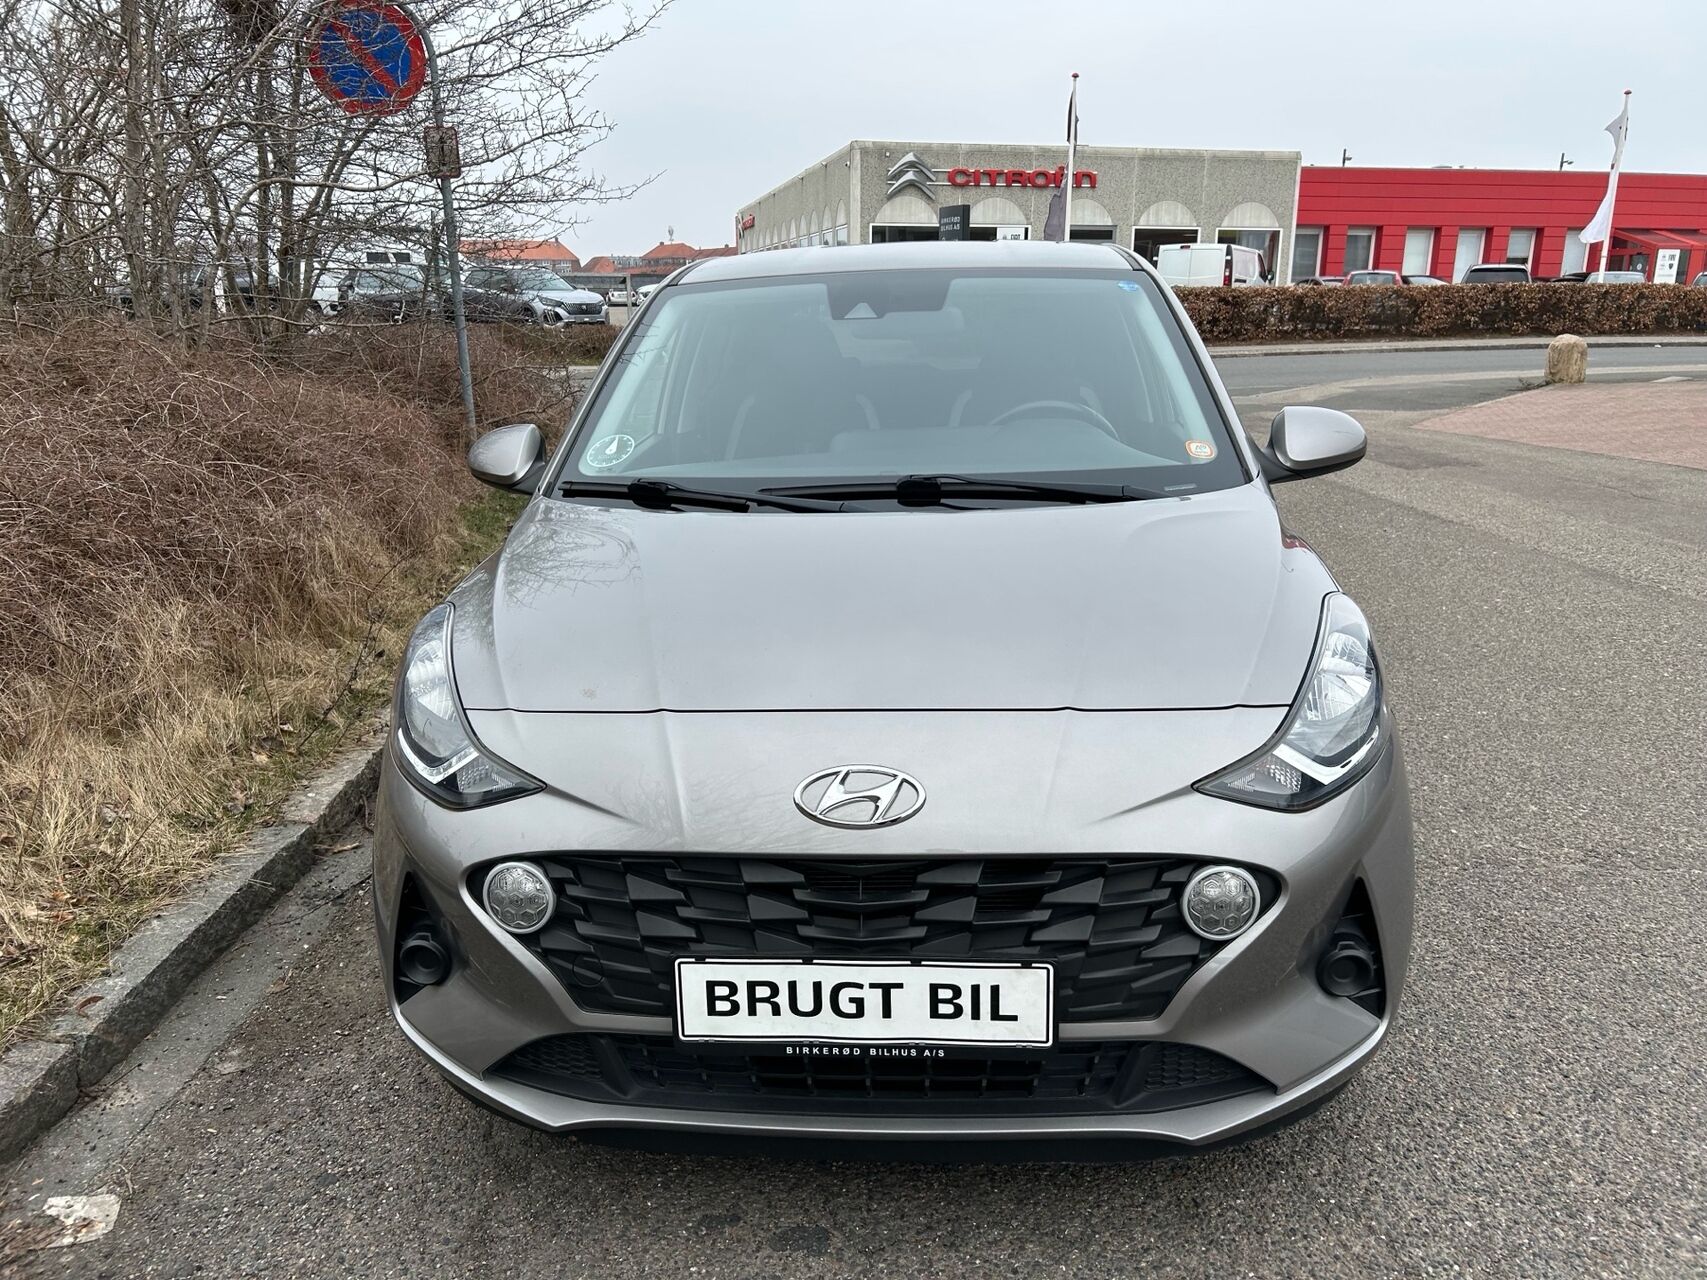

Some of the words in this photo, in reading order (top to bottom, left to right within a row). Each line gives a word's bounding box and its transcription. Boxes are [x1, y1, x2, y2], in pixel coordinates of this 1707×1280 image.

[705, 979, 904, 1020] BRUGT
[929, 982, 1019, 1022] BIL
[786, 1046, 861, 1055] BIRKERØD
[869, 1047, 917, 1057] BILHUS
[923, 1049, 945, 1057] A/S
